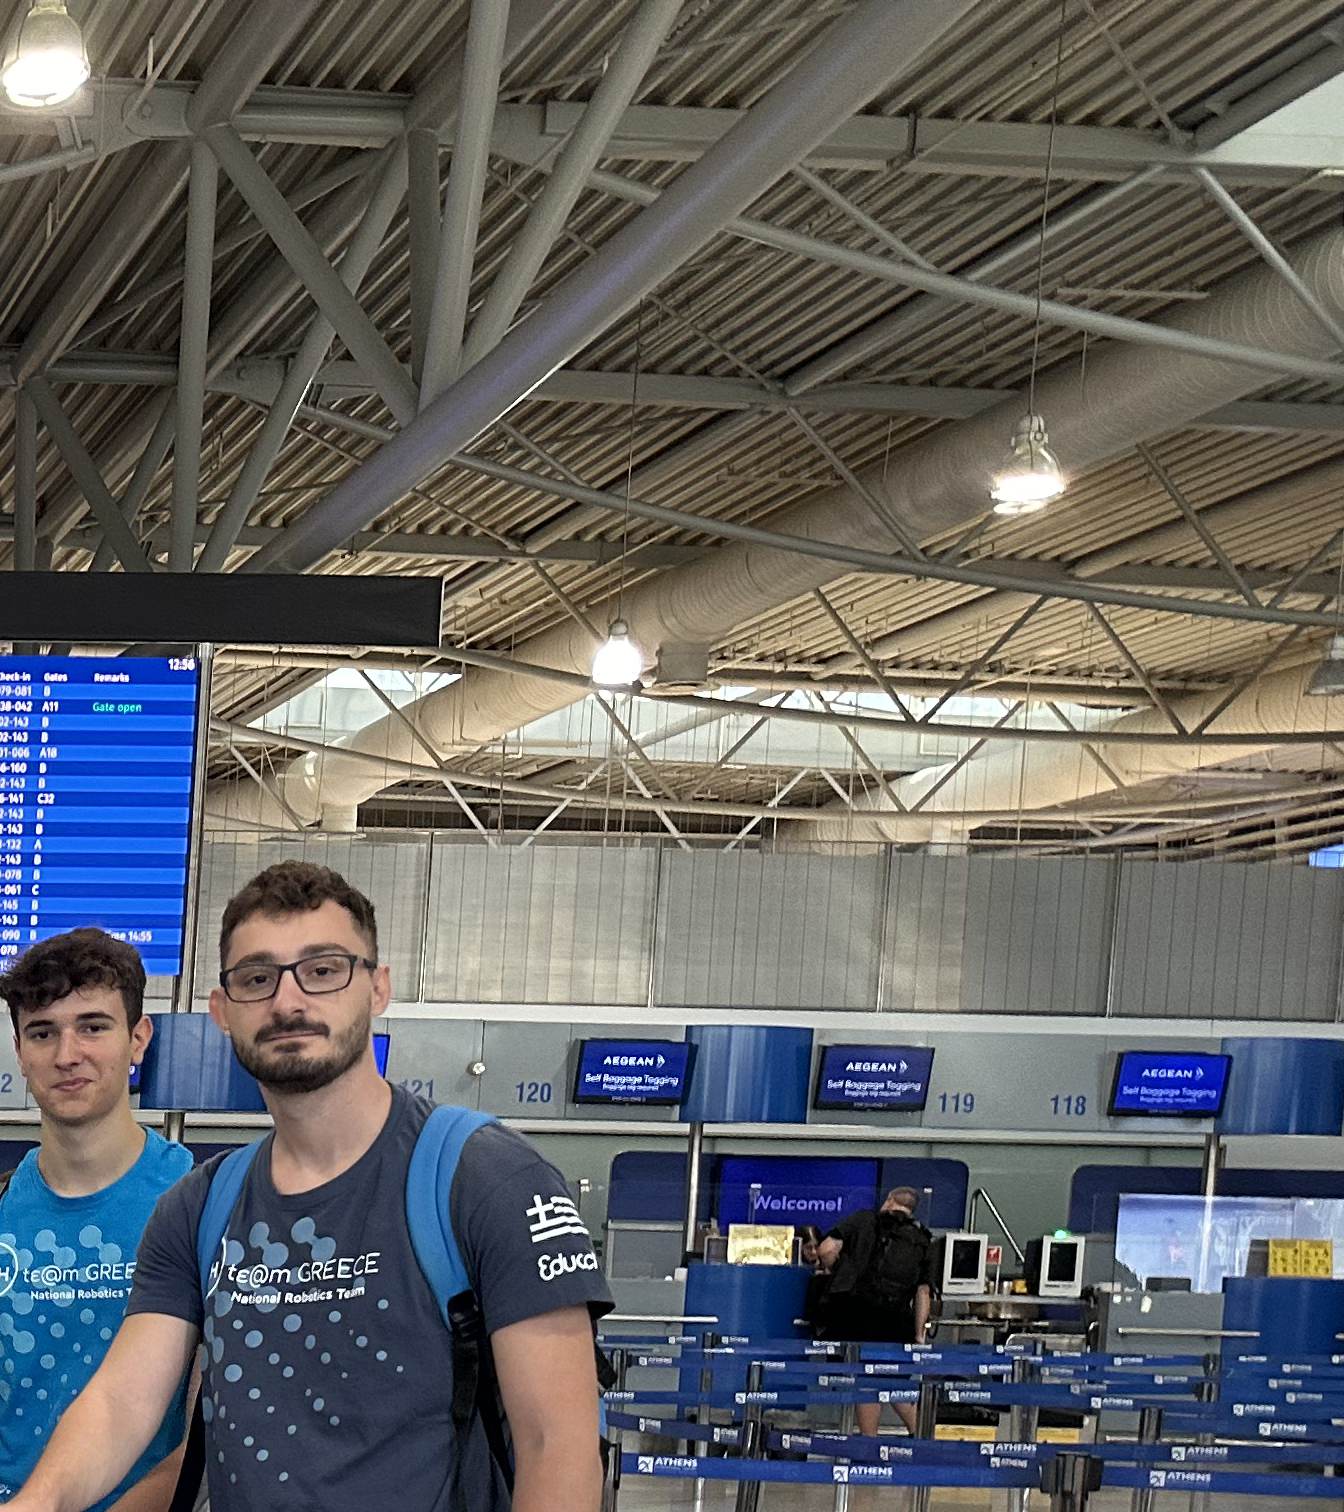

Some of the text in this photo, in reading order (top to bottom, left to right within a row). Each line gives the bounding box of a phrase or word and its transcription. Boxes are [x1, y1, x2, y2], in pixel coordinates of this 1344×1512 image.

[42, 702, 58, 712] A11
[93, 702, 142, 714] Gate open
[603, 1056, 654, 1066] AEGEAN
[846, 1062, 897, 1072] AEGEAN
[1142, 1068, 1193, 1079] AEGEAN
[516, 1082, 551, 1103] 120
[938, 1092, 975, 1114] 119
[1051, 1095, 1086, 1116] 118
[753, 1196, 843, 1212] Welcome!
[298, 1252, 380, 1282] GREECE
[31, 1288, 123, 1300] National Robotics
[231, 1286, 365, 1304] National Robotics Team
[1272, 1425, 1307, 1433] ATHENS
[996, 1443, 1036, 1453] ATHENS
[1186, 1448, 1228, 1456] ATHENS
[655, 1458, 697, 1468] ATHENS
[850, 1467, 892, 1477] ATHENS
[1167, 1472, 1211, 1483] ATHENS
